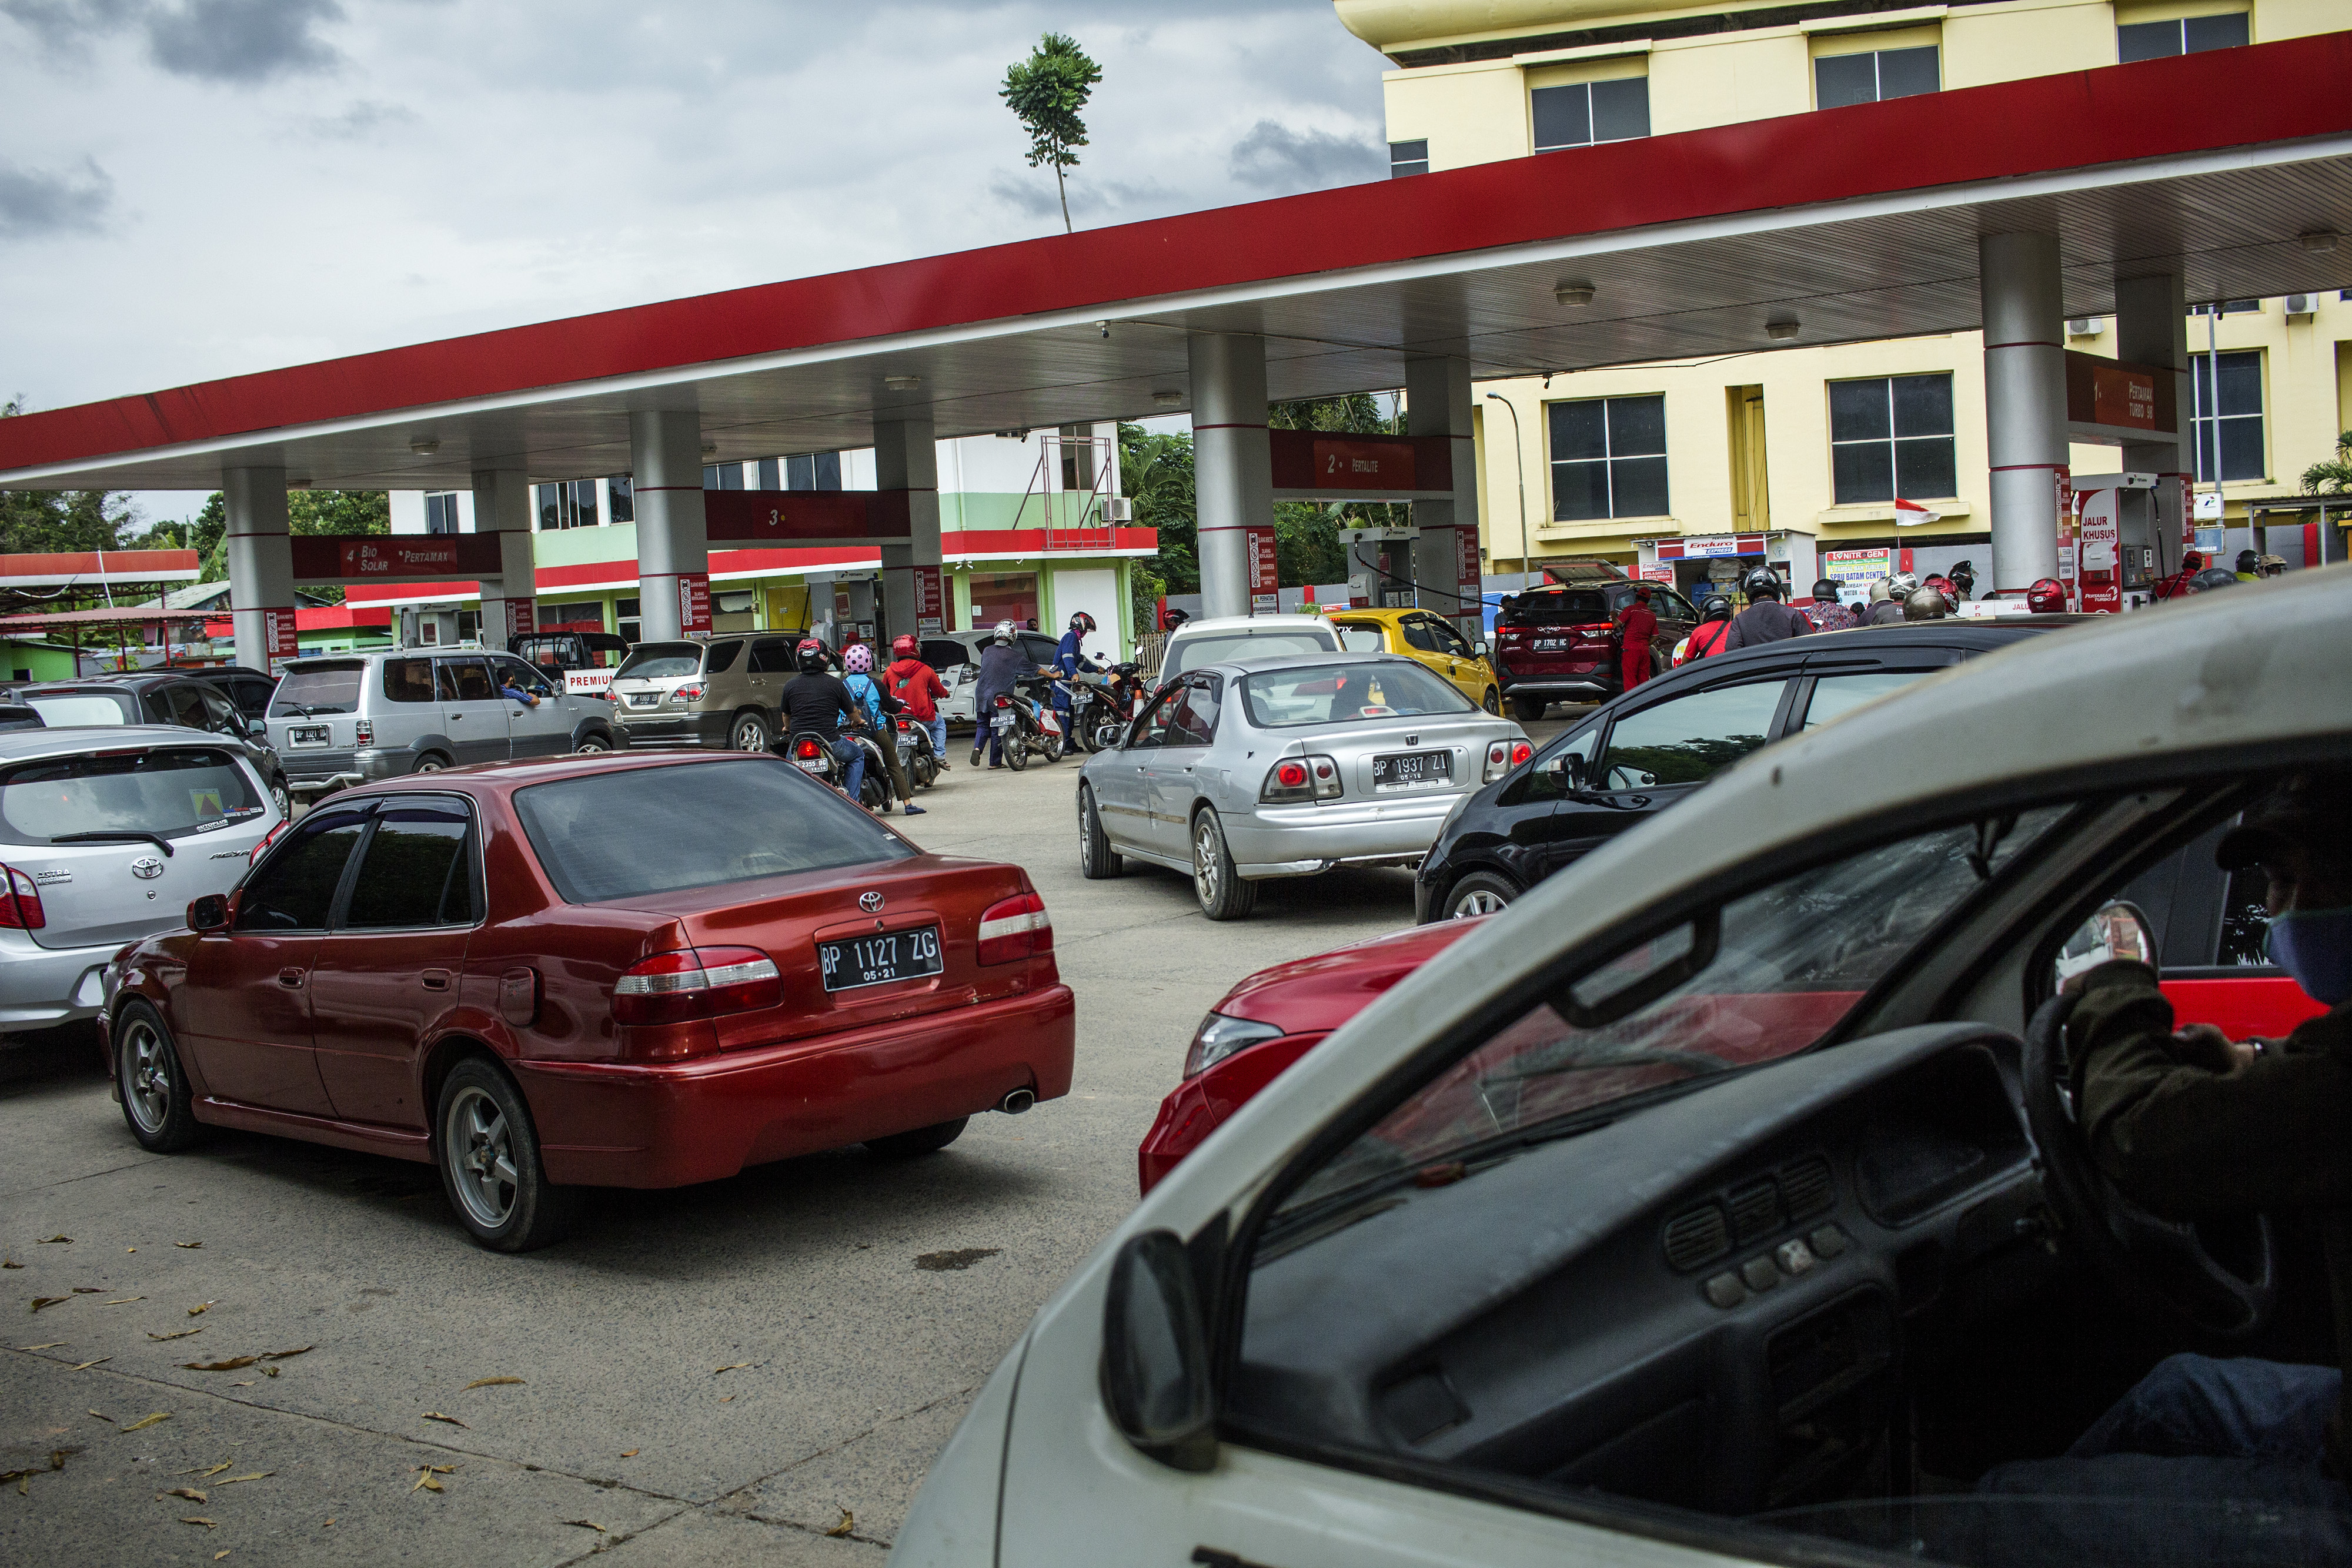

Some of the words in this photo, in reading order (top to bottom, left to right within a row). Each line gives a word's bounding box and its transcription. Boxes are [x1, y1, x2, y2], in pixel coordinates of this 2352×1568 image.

[2129, 381, 2153, 402] PERTAMAX
[2129, 402, 2144, 418] TURBO
[1327, 454, 1335, 473] 2
[1352, 458, 1378, 473] PERTALITE
[769, 509, 779, 526] 3
[2083, 516, 2108, 527] JALUR
[2083, 529, 2115, 540] KHUSUS
[347, 550, 354, 562] 4
[405, 550, 448, 563] PERTAMAX
[360, 559, 388, 571] SOLAR
[1846, 572, 1864, 580] BATAM
[296, 730, 303, 738] BP
[306, 730, 317, 738] 1321
[1374, 760, 1387, 776] BP
[1396, 756, 1424, 774] 1937
[1431, 754, 1446, 770] ZI
[196, 819, 228, 830] AUTOPLUS
[38, 868, 71, 878] ASTRA
[822, 945, 841, 974] BP
[854, 937, 897, 969] 1127
[909, 932, 936, 961] ZG
